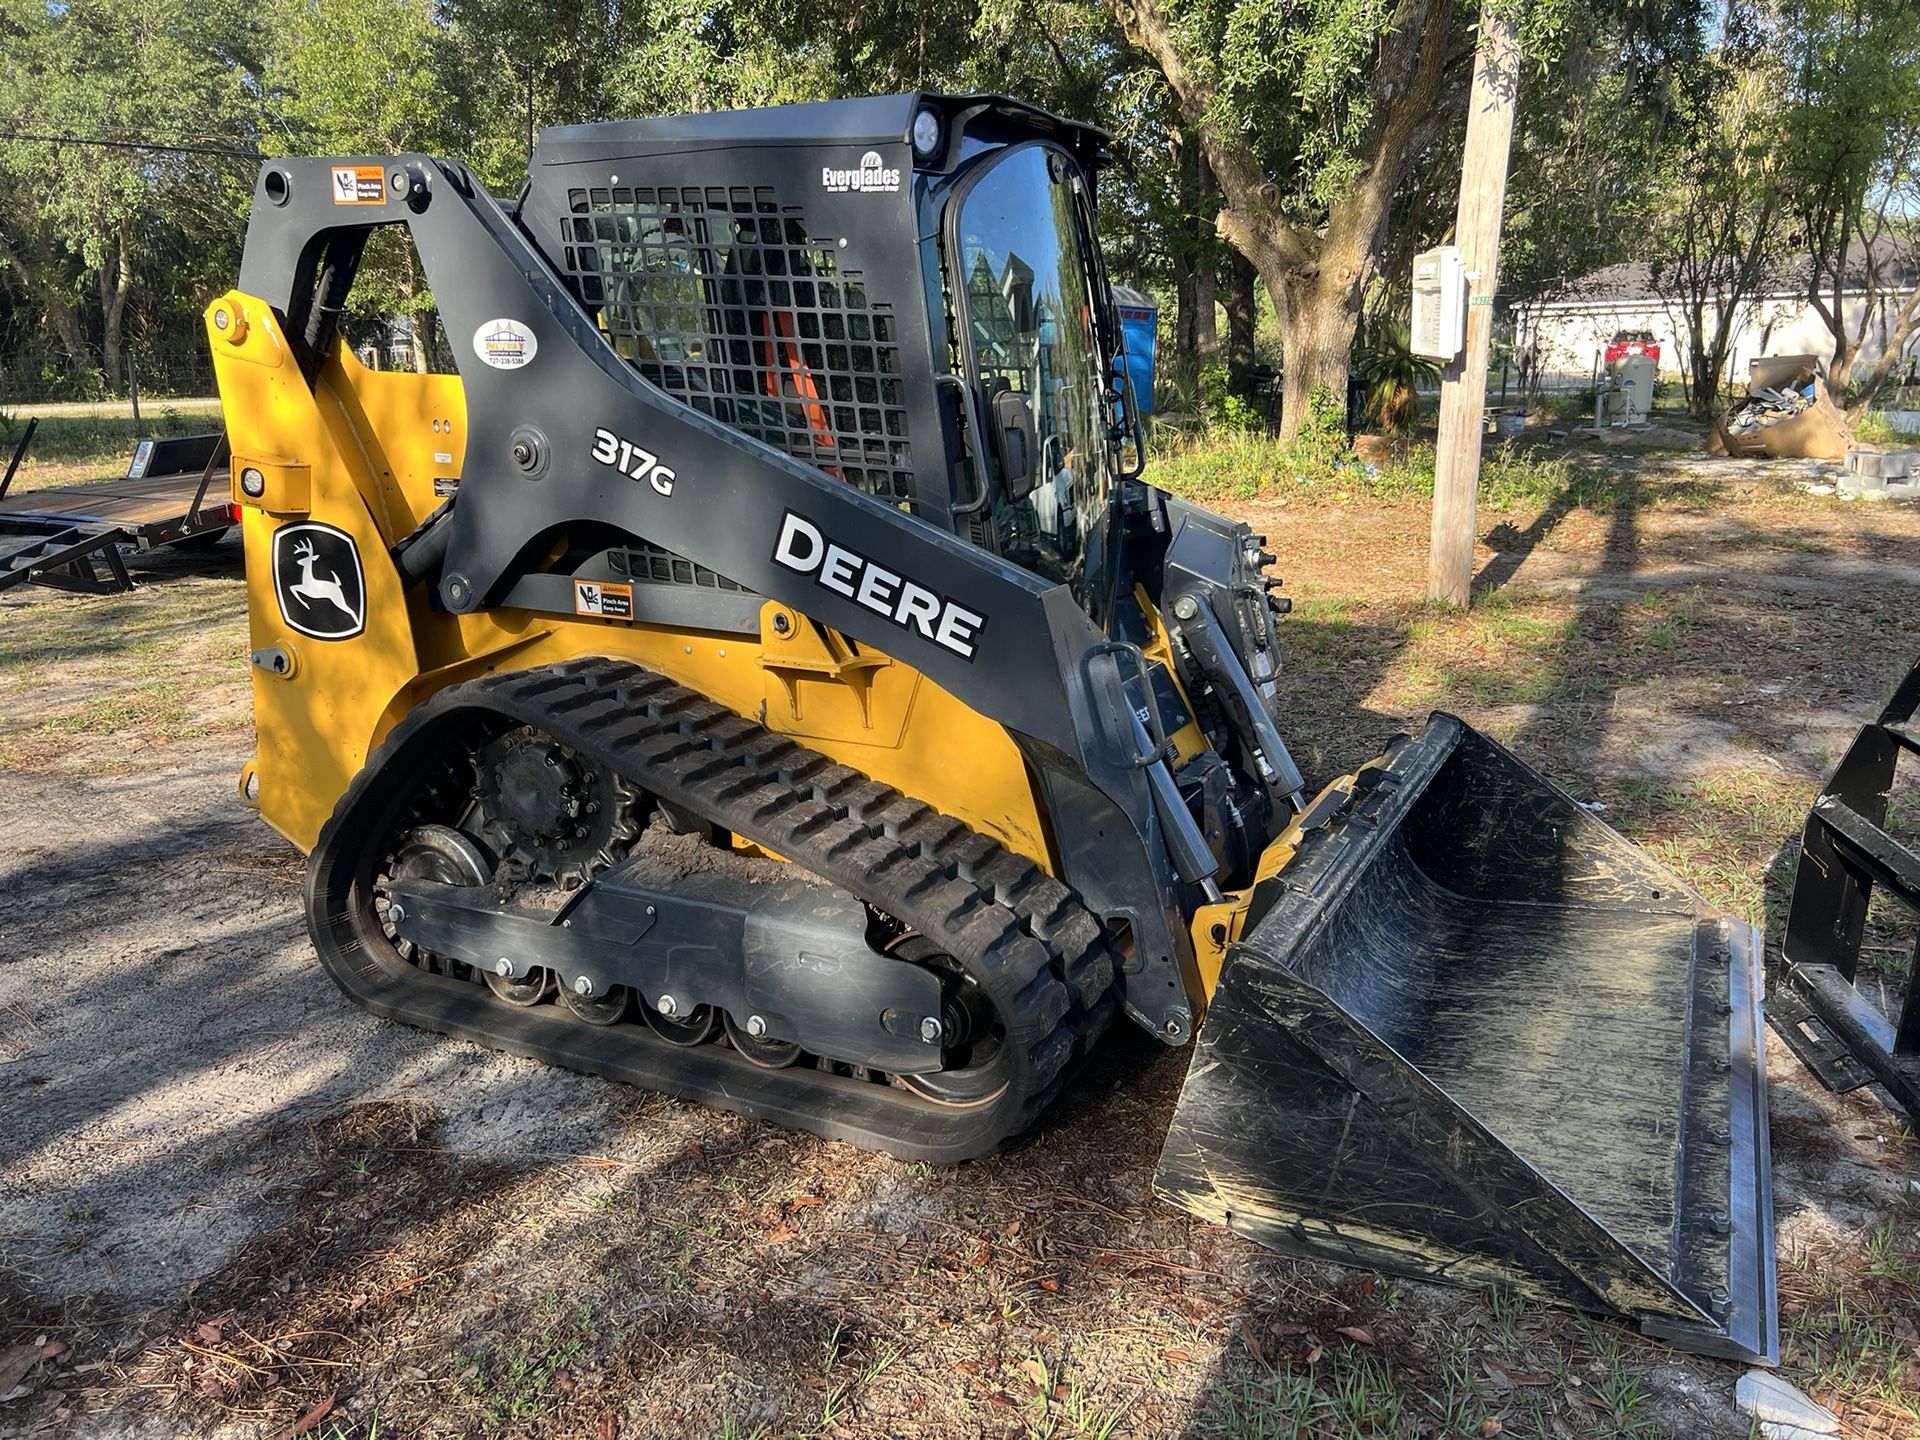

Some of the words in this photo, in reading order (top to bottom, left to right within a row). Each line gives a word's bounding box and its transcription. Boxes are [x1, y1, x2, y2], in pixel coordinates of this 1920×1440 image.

[822, 167, 900, 190] Everglades
[591, 428, 676, 497] 317G
[602, 597, 617, 605] Pinch
[774, 512, 984, 659] DEERE
